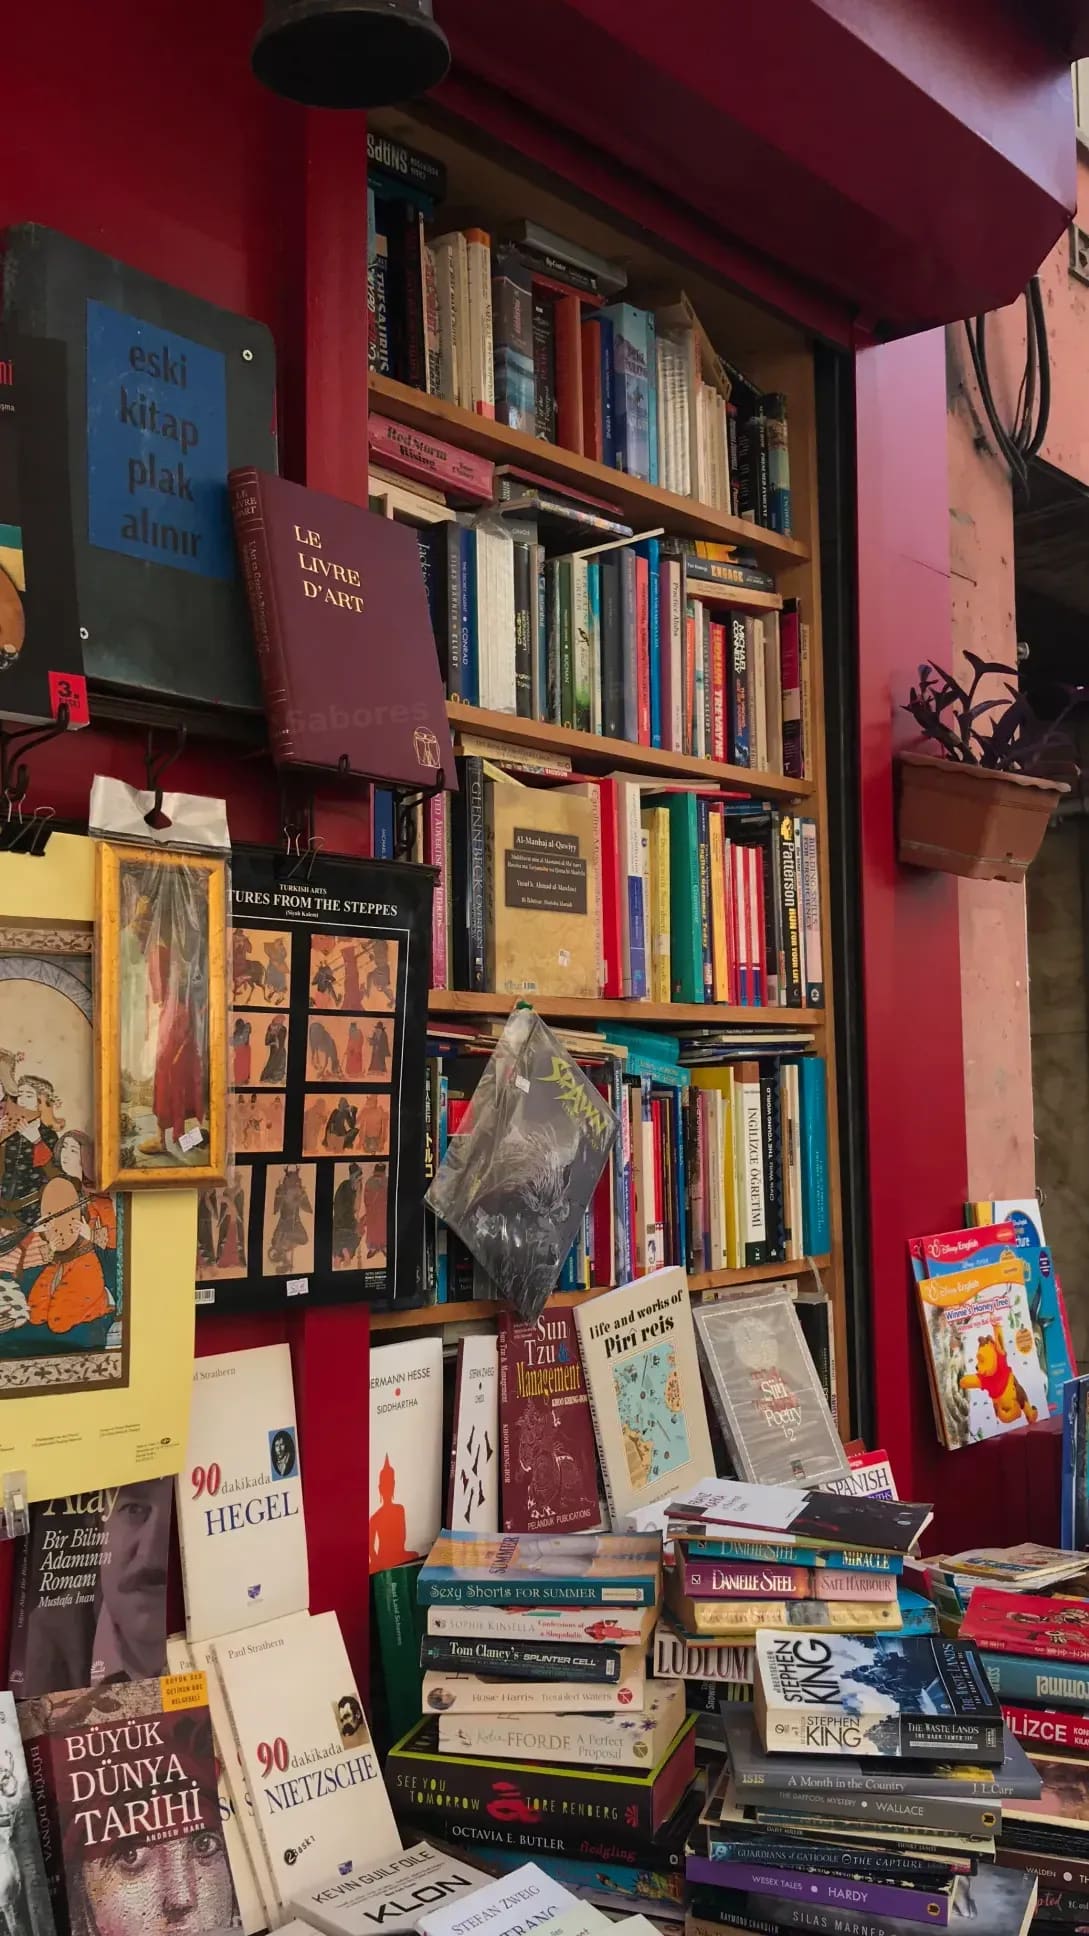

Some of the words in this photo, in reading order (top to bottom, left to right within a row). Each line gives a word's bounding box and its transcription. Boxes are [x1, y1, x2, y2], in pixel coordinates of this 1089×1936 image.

[368, 134, 408, 174] SNAPS
[376, 271, 389, 372] THESAURUS
[129, 345, 188, 389] eski
[118, 384, 200, 454] kitap
[387, 427, 411, 448] Red
[411, 439, 448, 461] Storm
[127, 453, 194, 502] plak
[120, 508, 202, 557] alınır
[294, 524, 322, 549] LE
[298, 552, 362, 588] LIVRE
[303, 580, 364, 613] D'ART
[711, 629, 724, 685] LUDLUM
[732, 620, 741, 675] CONNELLY
[738, 624, 746, 672] MICHAEL
[713, 689, 726, 760] TREVAYNE
[470, 782, 481, 843] GLENN
[471, 846, 482, 890] BECK
[783, 841, 796, 907] Patterson
[809, 837, 817, 889] BUILDING
[279, 883, 310, 893] TURKISH
[310, 887, 328, 895] ARTS
[273, 894, 312, 909] FROM
[314, 897, 341, 912] THE
[343, 901, 399, 918] STEPPES
[788, 908, 797, 930] RUN
[748, 1107, 759, 1165] İNGİLİZCE
[751, 1167, 764, 1228] ÖĞRETİMİ
[958, 1240, 979, 1252] English
[614, 1310, 634, 1329] and
[637, 1296, 670, 1320] works
[671, 1289, 684, 1304] of
[946, 1307, 972, 1321] Winnie's
[973, 1302, 994, 1313] Honey
[995, 1298, 1009, 1308] Tree
[537, 1314, 568, 1344] Sun
[640, 1314, 675, 1343] reis
[524, 1339, 556, 1367] Tzu
[557, 1343, 572, 1364] &
[199, 1367, 236, 1381] Strathern
[370, 1372, 406, 1389] ERMANN
[407, 1367, 431, 1381] HESSE
[501, 1365, 509, 1403] Management
[515, 1361, 581, 1400] Management
[376, 1398, 418, 1415] SIDDHARTHA
[763, 1406, 802, 1428] Poetry
[191, 1462, 222, 1500] 90
[221, 1476, 271, 1496] dakikada
[825, 1467, 890, 1496] SPANISH
[42, 1487, 121, 1522] Atay
[204, 1491, 299, 1537] HEGEL
[528, 1518, 555, 1531] PELANDUK
[556, 1509, 591, 1526] PUBLICATIONS
[41, 1530, 67, 1550] Bir
[70, 1527, 110, 1548] Bilim
[39, 1550, 112, 1571] Adamının
[489, 1535, 520, 1576] SUMMER
[841, 1550, 891, 1570] MIRACLE
[38, 1572, 97, 1592] Romanı
[429, 1584, 463, 1601] Sexy
[466, 1583, 513, 1599] Shorts
[515, 1587, 540, 1599] FOR
[543, 1588, 596, 1599] SUMMER
[712, 1569, 760, 1592] DANIELLE
[759, 1569, 798, 1592] STEEL
[820, 1575, 846, 1591] SAFE
[846, 1576, 892, 1593] HARBOUR
[38, 1594, 73, 1609] Mustafa
[450, 1620, 484, 1632] SOPHIE
[487, 1621, 536, 1634] KINSELLA
[228, 1647, 247, 1660] Paul
[247, 1637, 285, 1655] Strathern
[449, 1640, 474, 1656] Tom
[475, 1643, 520, 1661] Clancy's
[523, 1653, 570, 1665] SPLINTER
[572, 1657, 598, 1667] CELL
[657, 1640, 749, 1680] LUDLUM
[774, 1639, 803, 1703] STEPHEN
[793, 1639, 840, 1705] KING
[472, 1693, 500, 1703] Rosie
[502, 1692, 535, 1702] Harris
[541, 1691, 580, 1702] Troubled
[581, 1691, 613, 1702] Waters
[806, 1715, 860, 1729] STEPHEN
[907, 1722, 924, 1735] THE
[925, 1723, 949, 1735] WASTE
[950, 1724, 980, 1736] LANDS
[63, 1719, 165, 1762] BÜYÜK
[507, 1731, 572, 1752] FFORDE
[577, 1735, 586, 1746] A
[588, 1734, 624, 1748] Perfect
[806, 1728, 862, 1748] KING
[256, 1736, 290, 1779] 90
[290, 1742, 344, 1769] dakikada
[578, 1747, 623, 1762] Proposal
[29, 1745, 47, 1804] BÜYÜK
[69, 1753, 189, 1804] DÜNYA
[263, 1754, 378, 1816] NIETZSCHE
[397, 1774, 418, 1789] SEE
[421, 1776, 447, 1792] YOU
[741, 1773, 765, 1785] ISIS
[788, 1776, 798, 1787] A
[799, 1776, 833, 1789] Month
[835, 1778, 846, 1789] in
[847, 1777, 863, 1790] the
[864, 1778, 906, 1794] Country
[990, 1784, 1014, 1796] Carr
[75, 1779, 204, 1847] TARİHİ
[410, 1790, 481, 1811] TOMORROW
[526, 1796, 556, 1814] TORE
[562, 1801, 619, 1820] RENBERG
[826, 1796, 857, 1808] MYSTERY
[875, 1802, 925, 1817] WALLACE
[36, 1804, 53, 1863] DÜNYA
[146, 1827, 180, 1843] ANDREW
[183, 1823, 206, 1835] MARR
[452, 1825, 504, 1843] OCTAVIA
[506, 1832, 517, 1844] E.
[519, 1836, 566, 1852] BUTLER
[736, 1848, 787, 1862] GUARDIANS
[852, 1856, 873, 1867] THE
[874, 1857, 924, 1870] CAPTURE
[1026, 1866, 1057, 1879] WALDEN
[311, 1876, 361, 1905] KEVIN
[358, 1850, 436, 1886] GUILFOILE
[780, 1879, 803, 1891] TALES
[828, 1886, 869, 1904] HARDY
[362, 1873, 474, 1924] KLON
[450, 1904, 505, 1936] STEFAN
[497, 1884, 541, 1911] ZWEIG
[792, 1911, 829, 1929] SILAS
[834, 1920, 886, 1936] MARNER
